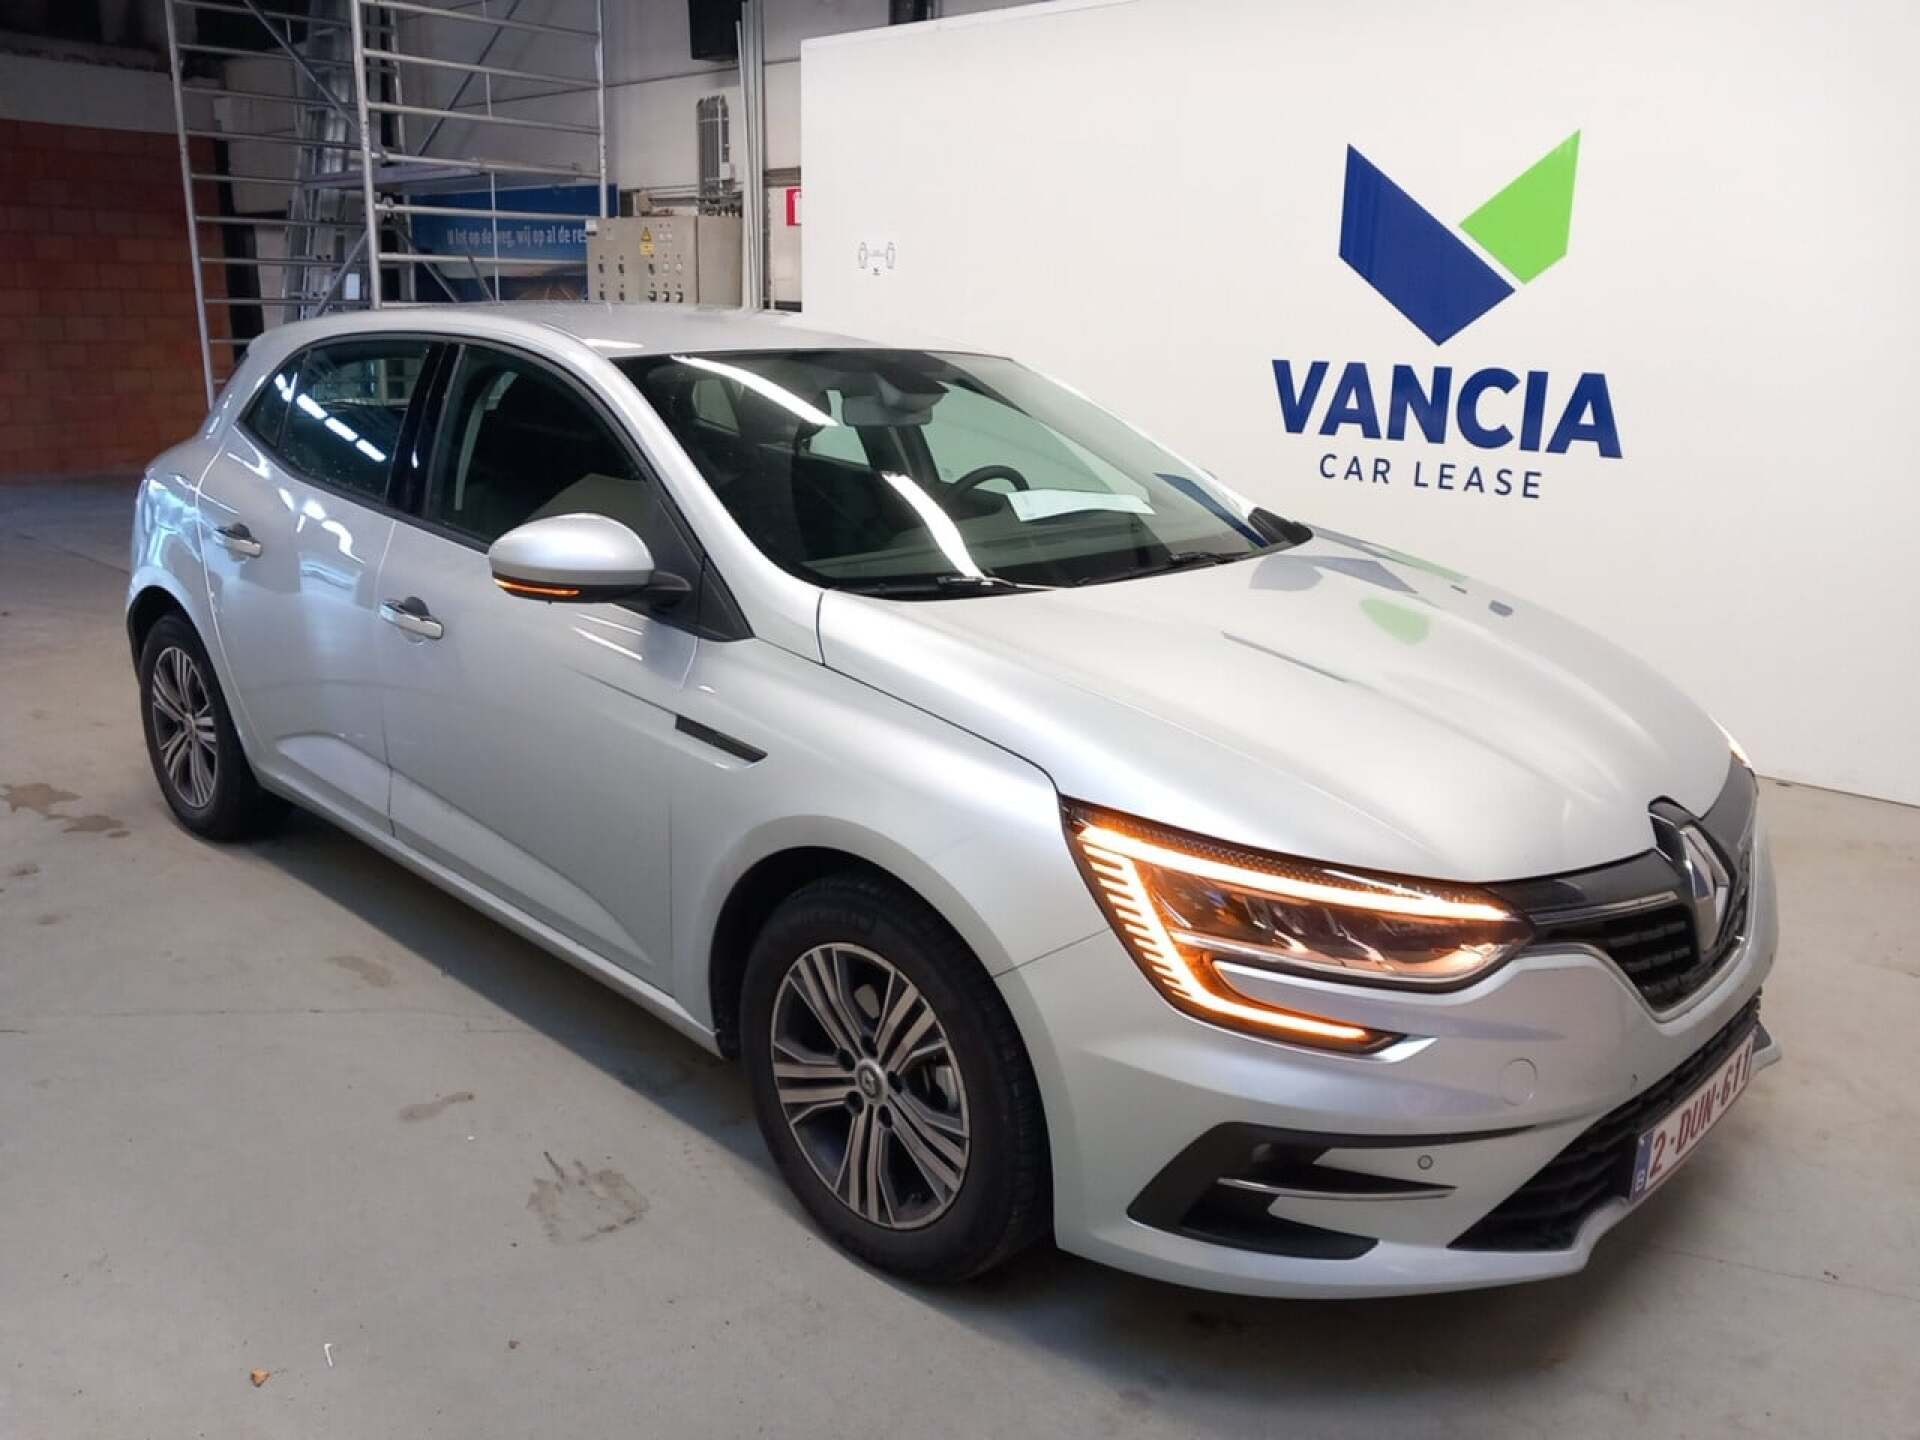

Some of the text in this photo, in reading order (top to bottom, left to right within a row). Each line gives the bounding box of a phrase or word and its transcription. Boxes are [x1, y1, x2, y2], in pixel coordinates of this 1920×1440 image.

[532, 229, 545, 249] op
[546, 225, 556, 244] al
[557, 225, 571, 245] de
[1272, 359, 1623, 459] VANCIA
[1319, 453, 1543, 499] CAR LEASE
